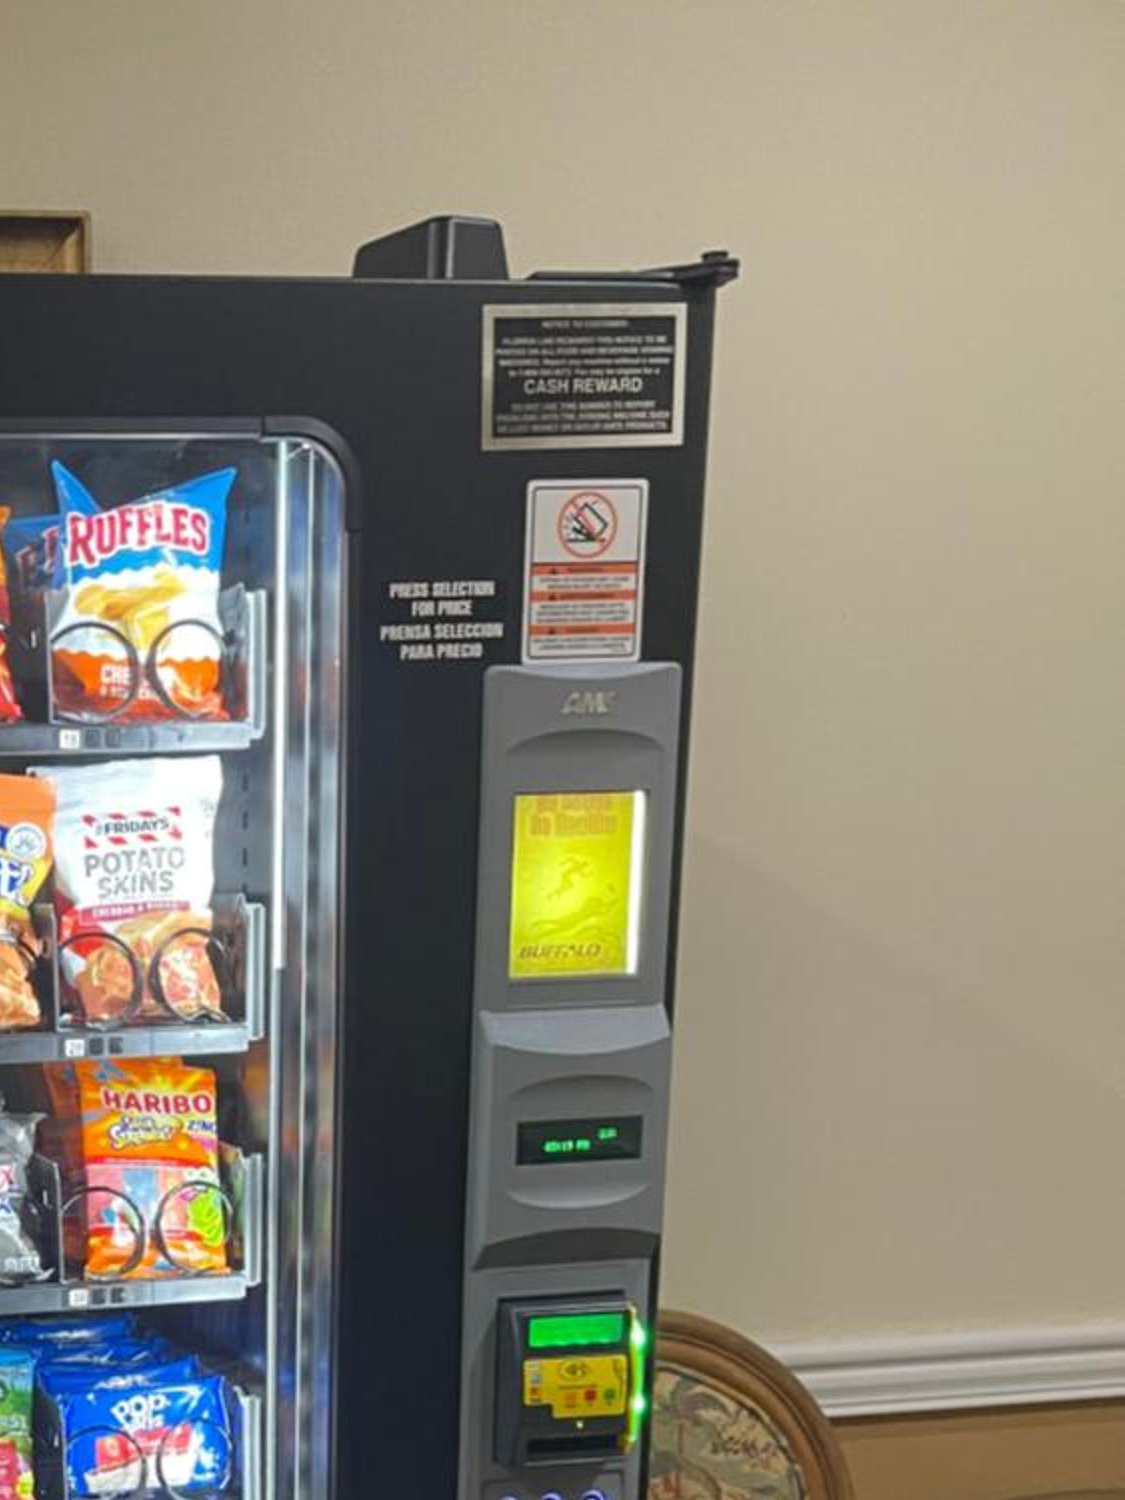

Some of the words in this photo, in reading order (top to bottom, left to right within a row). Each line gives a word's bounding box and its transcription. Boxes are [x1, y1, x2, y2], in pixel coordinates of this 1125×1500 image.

[524, 378, 569, 394] CASH
[574, 377, 643, 393] REWARD
[68, 501, 210, 569] RUFFLES
[388, 583, 430, 598] PRESS
[432, 580, 495, 597] SELECTION
[411, 602, 436, 617] FOR
[438, 600, 473, 616] PRICE
[380, 625, 431, 641] PRENSA
[434, 622, 504, 639] SELECCION
[400, 644, 434, 660] PARA
[437, 642, 483, 659] PRECIO
[83, 846, 185, 878] POTATO
[97, 870, 174, 898] SKINS
[518, 943, 602, 960] BUFFALO
[102, 1087, 213, 1115] HARIBO
